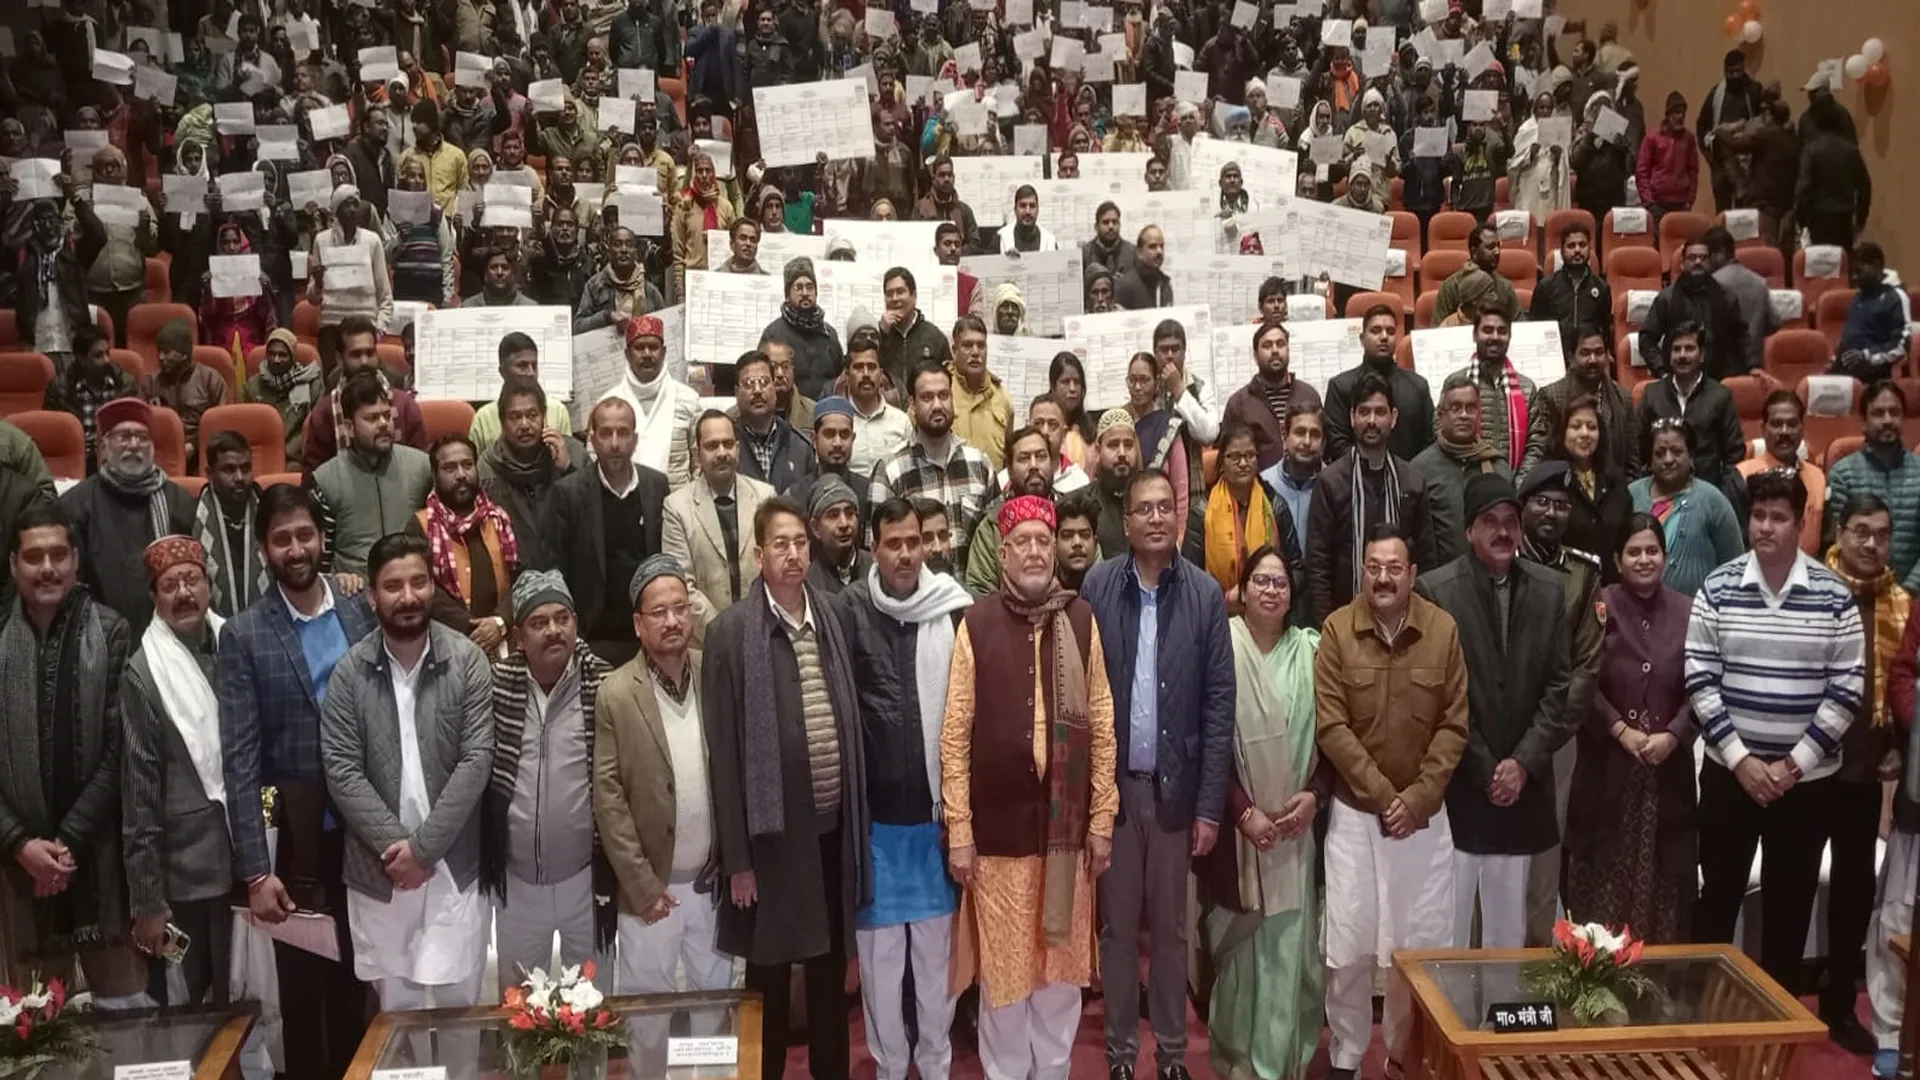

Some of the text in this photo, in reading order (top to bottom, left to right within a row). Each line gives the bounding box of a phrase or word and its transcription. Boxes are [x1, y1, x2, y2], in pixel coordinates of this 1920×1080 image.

[1495, 1005, 1553, 1027] मा० मंत्री जी
